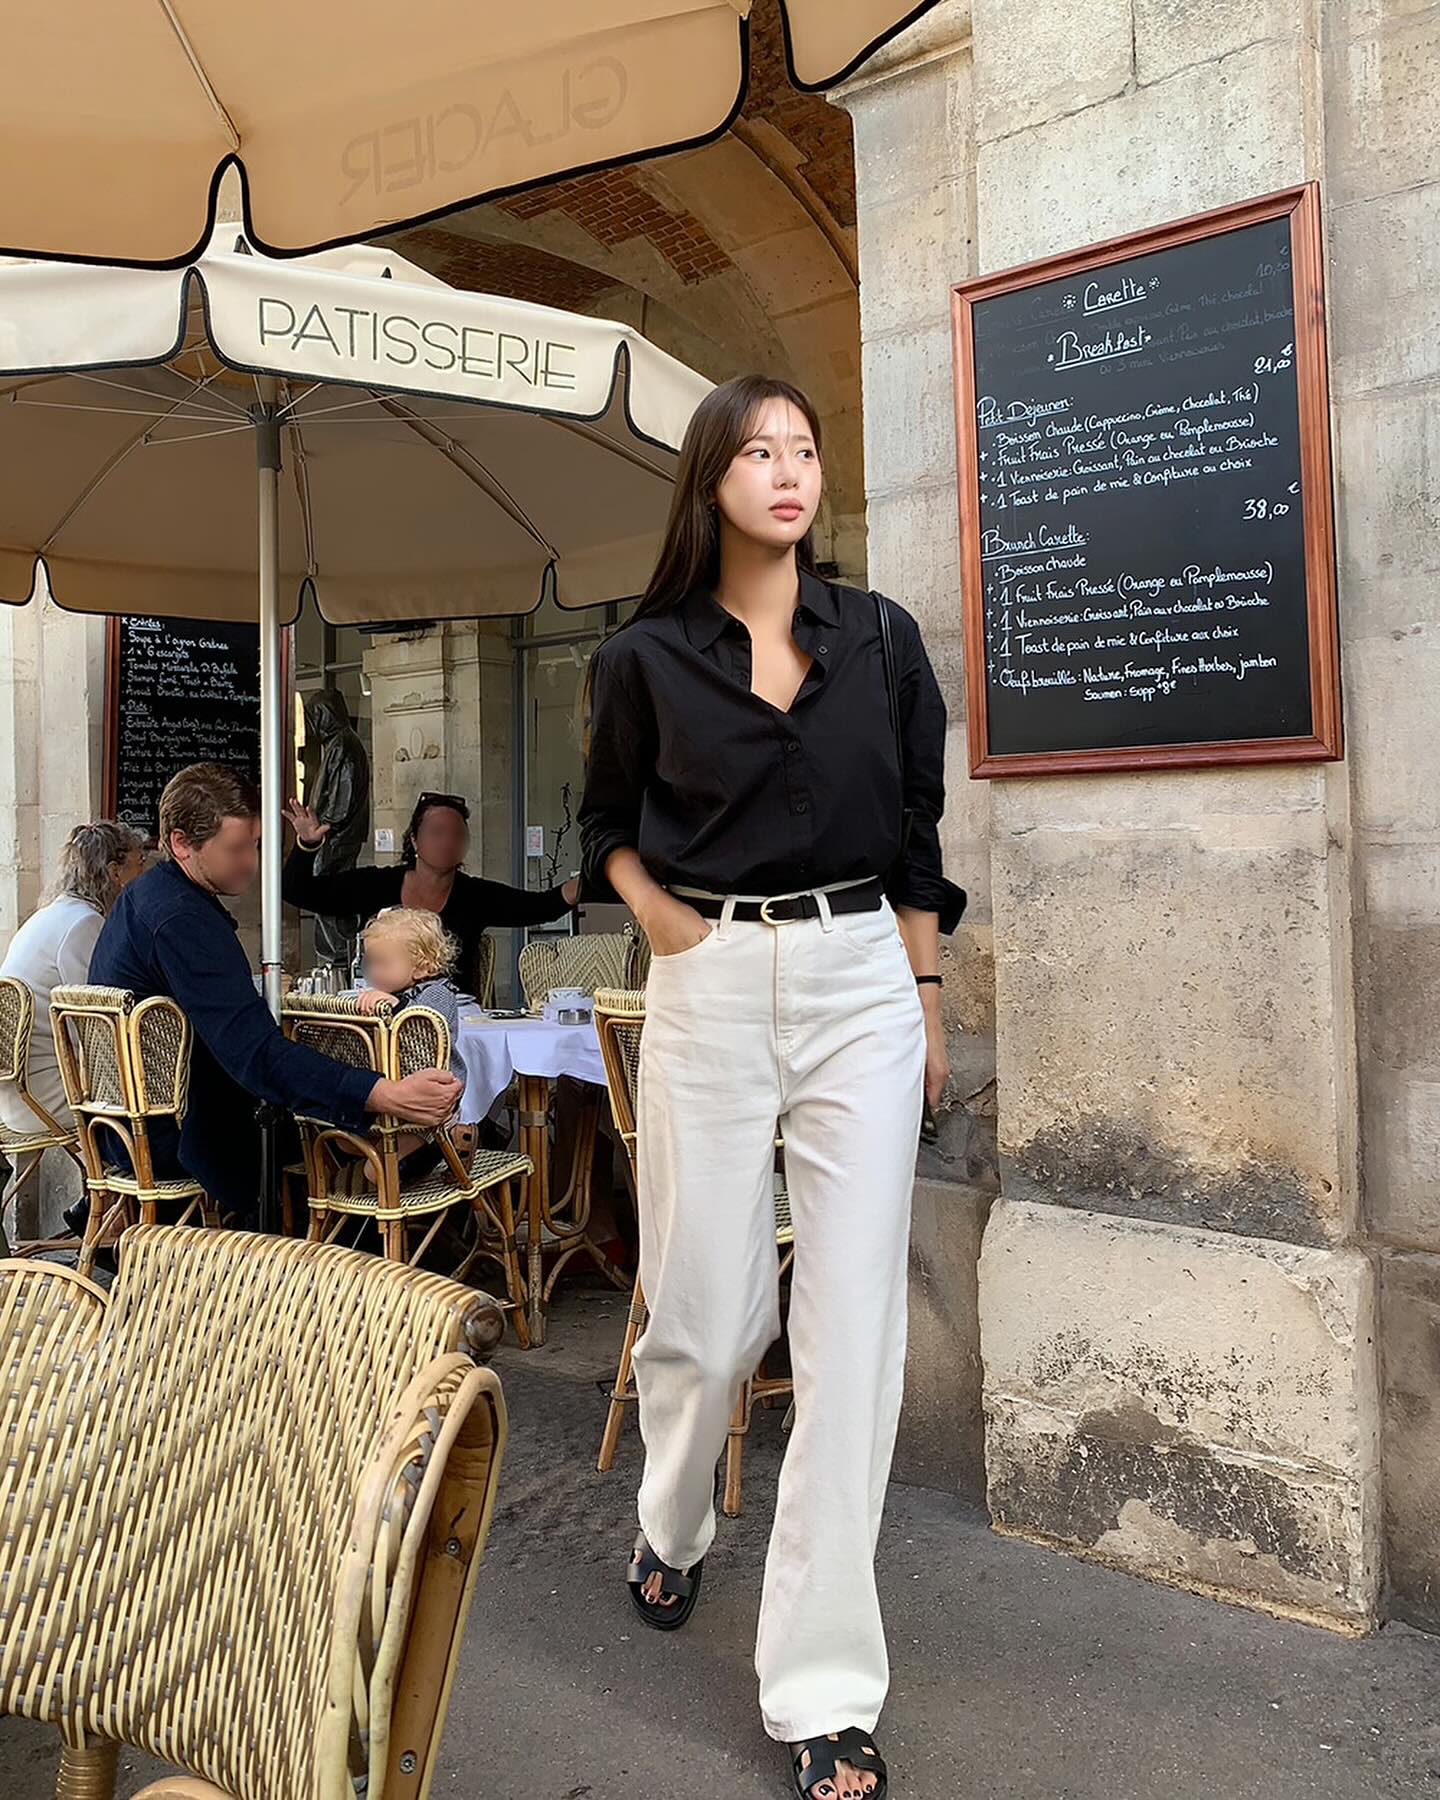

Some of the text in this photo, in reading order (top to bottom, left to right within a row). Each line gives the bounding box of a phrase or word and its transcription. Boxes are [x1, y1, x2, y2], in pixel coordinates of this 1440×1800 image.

[1083, 277, 1147, 311] Carette
[259, 297, 577, 390] PATISSERIE
[977, 396, 1004, 426] Petit
[996, 432, 1041, 448] Boisson
[997, 447, 1026, 466] Fruit
[1063, 433, 1106, 456] Pressé
[1160, 429, 1175, 440] ou
[1148, 454, 1161, 464] au
[1163, 443, 1205, 461] chocolat
[1209, 443, 1224, 454] ou
[1225, 432, 1279, 452] Brioche
[1009, 490, 1039, 507] Toast
[1045, 488, 1059, 501] de
[1063, 484, 1088, 505] pain
[1093, 480, 1107, 493] de
[1110, 476, 1130, 488] mie
[1143, 465, 1199, 486] Confiture
[1220, 457, 1253, 472] choix
[981, 527, 1036, 556] Brunch
[998, 564, 1045, 584] Boisson
[1015, 584, 1043, 603] Fruit
[1075, 578, 1115, 596] Pressé
[1169, 577, 1183, 587] ou
[1015, 632, 1050, 656] Toast
[1051, 638, 1065, 652] de
[1065, 639, 1090, 656] pain
[1106, 635, 1126, 647] mie
[1139, 627, 1190, 653] Confiture
[1212, 625, 1239, 639] choix
[1171, 657, 1198, 675] Fines
[1236, 653, 1277, 680] jambon
